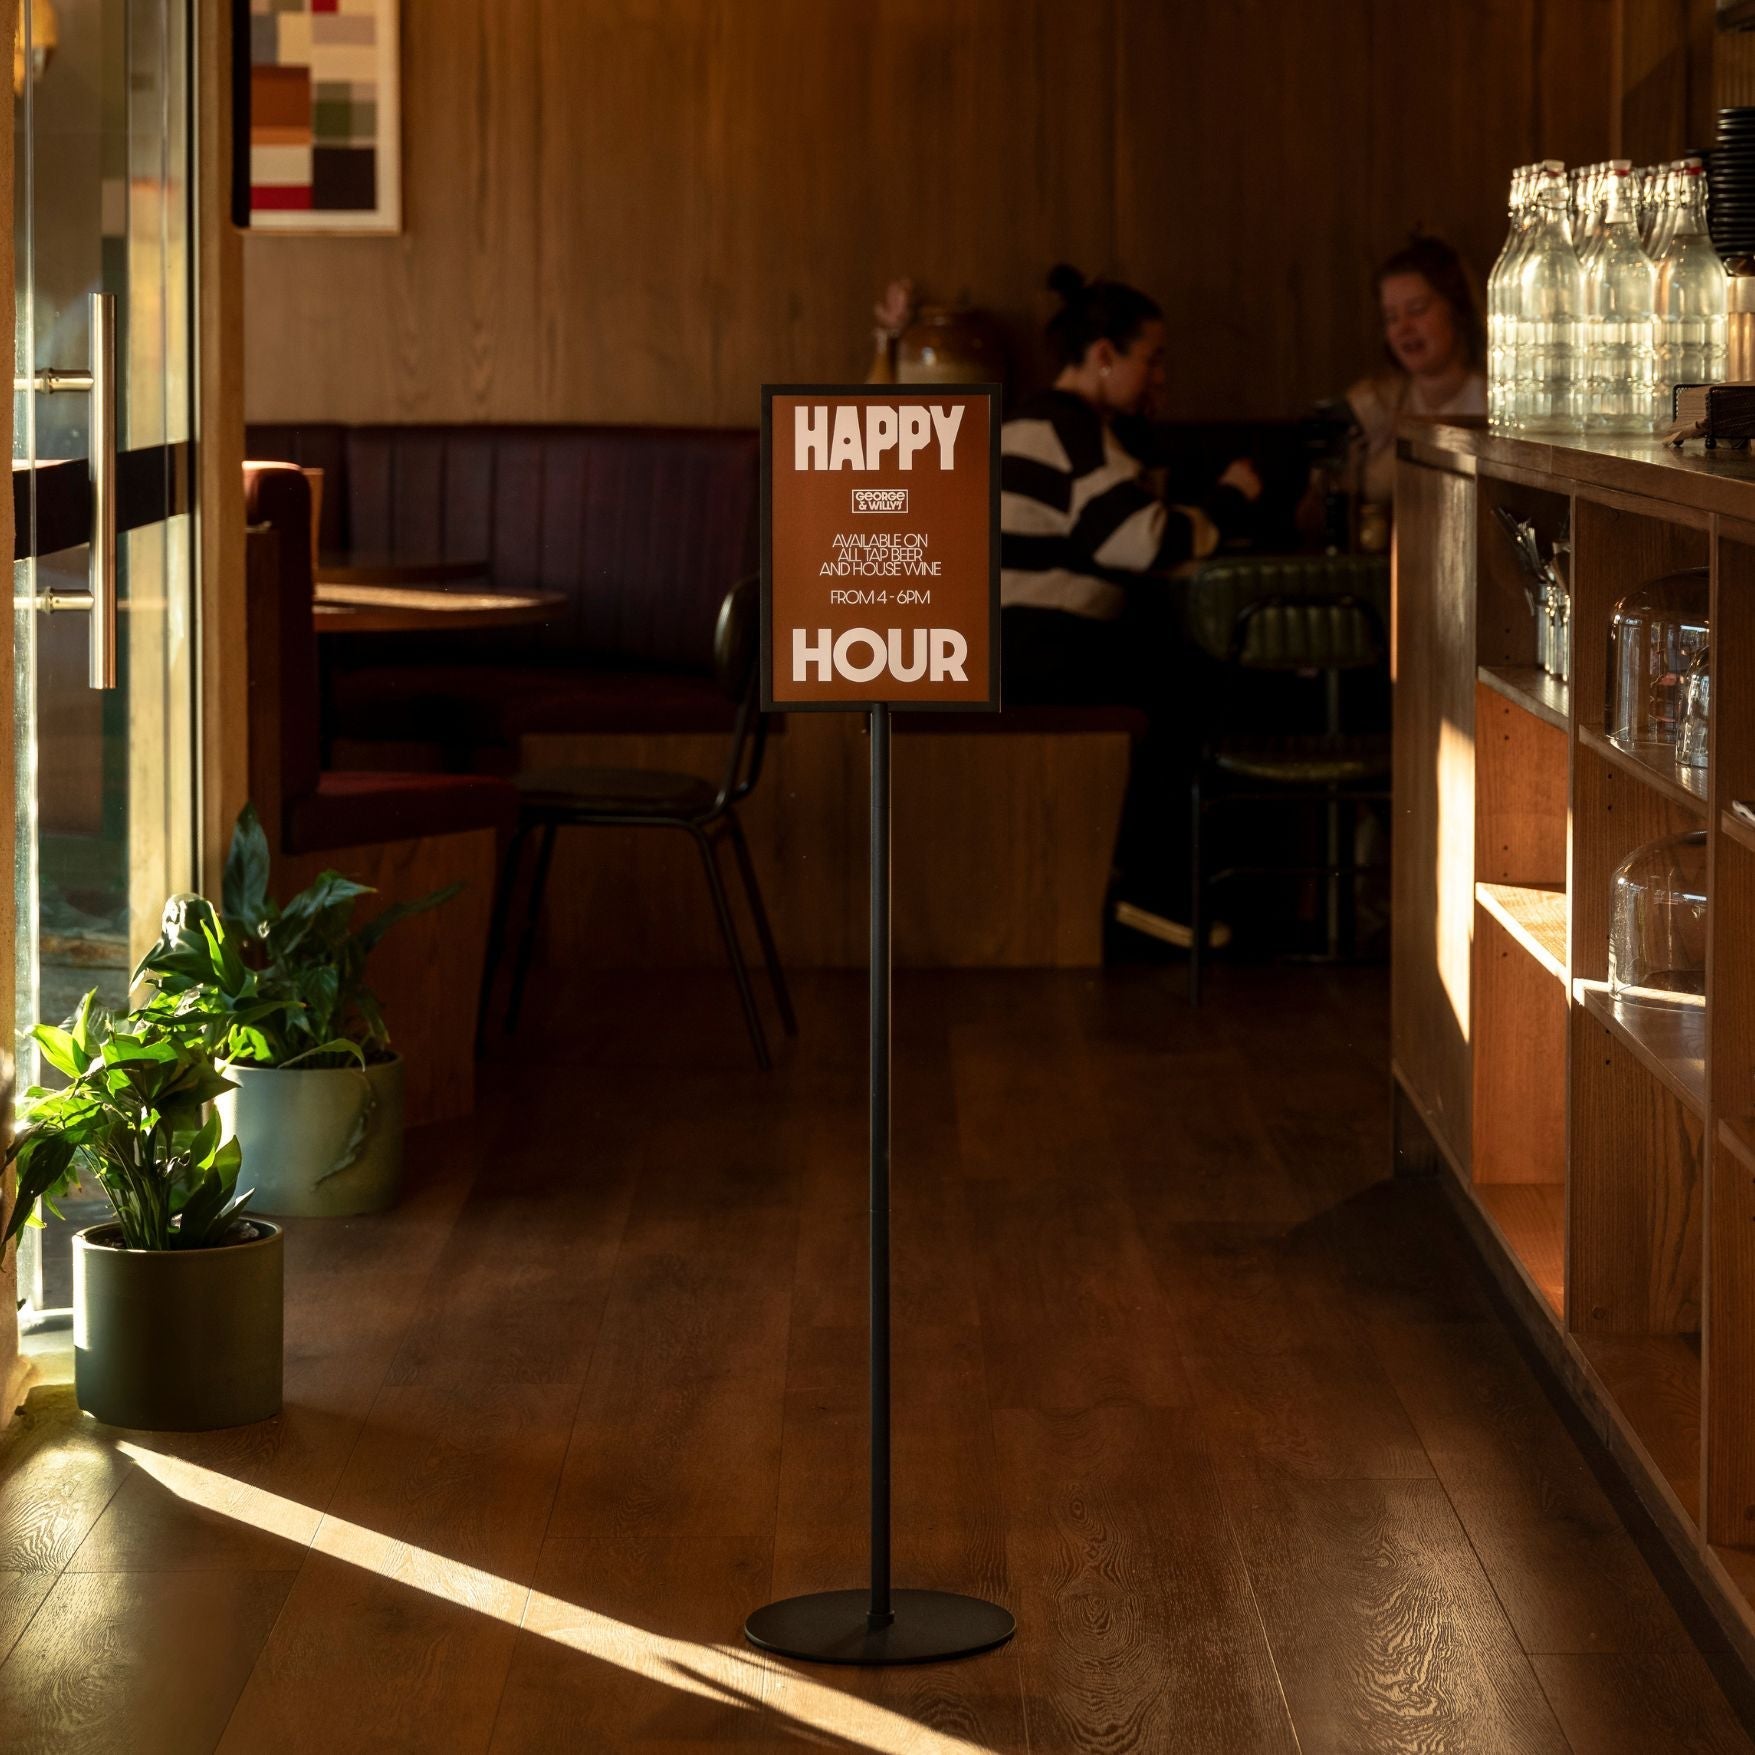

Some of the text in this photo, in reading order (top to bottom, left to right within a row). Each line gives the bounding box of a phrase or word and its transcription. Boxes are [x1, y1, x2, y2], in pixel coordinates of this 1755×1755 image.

[795, 405, 966, 471] HAPPY
[858, 500, 868, 510] &
[832, 533, 928, 548] AVAILABLE ON
[838, 547, 923, 562] ALL TAP BEER
[819, 561, 942, 576] AND HOUSE WINE
[830, 590, 875, 605] FROM
[876, 590, 888, 605] 4
[896, 590, 931, 605] 6PM
[792, 627, 969, 684] HOUR
